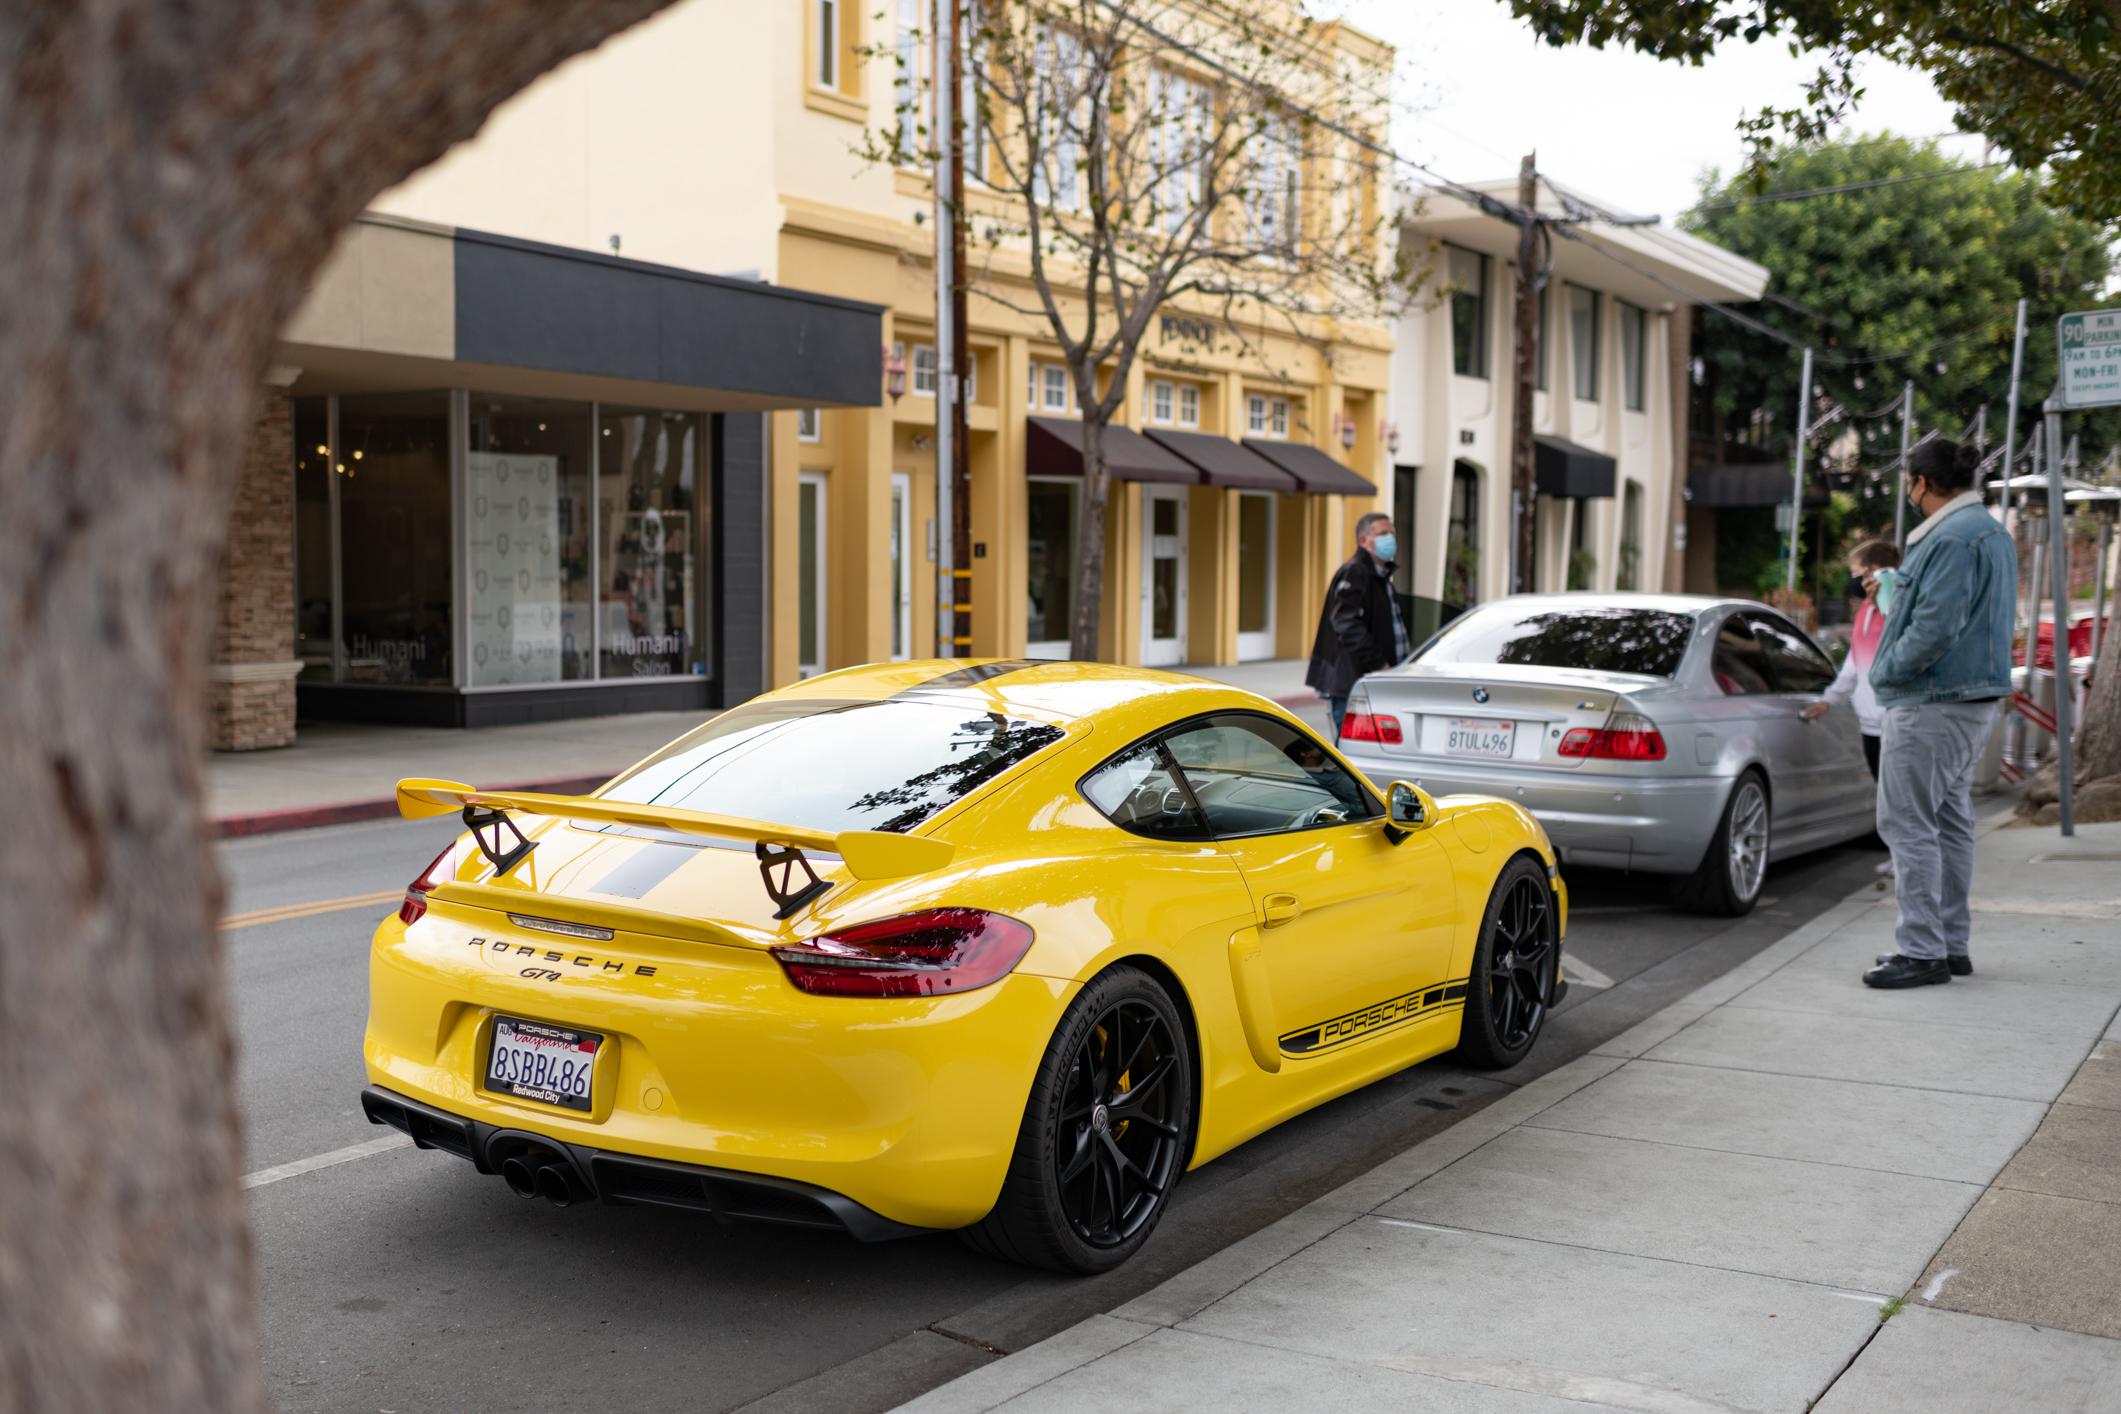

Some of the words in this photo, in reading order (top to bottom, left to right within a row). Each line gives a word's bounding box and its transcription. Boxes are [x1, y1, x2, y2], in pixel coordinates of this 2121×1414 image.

[2097, 317, 2114, 328] MIN
[2064, 324, 2082, 342] 90
[2091, 350, 2100, 359] TO
[2074, 363, 2117, 379] MON-FRI
[353, 633, 426, 660] Humani
[612, 629, 680, 656] Humani
[631, 658, 672, 677] Salon
[1449, 731, 1509, 752] 8TUL496
[468, 937, 658, 977] PORSCHE
[520, 967, 562, 982] GT4
[1324, 995, 1421, 1042] PORSCHE
[518, 1024, 574, 1040] PORSCHE
[494, 1046, 590, 1095] 8SBB486
[512, 1084, 544, 1100] Redwood
[545, 1090, 560, 1104] City
